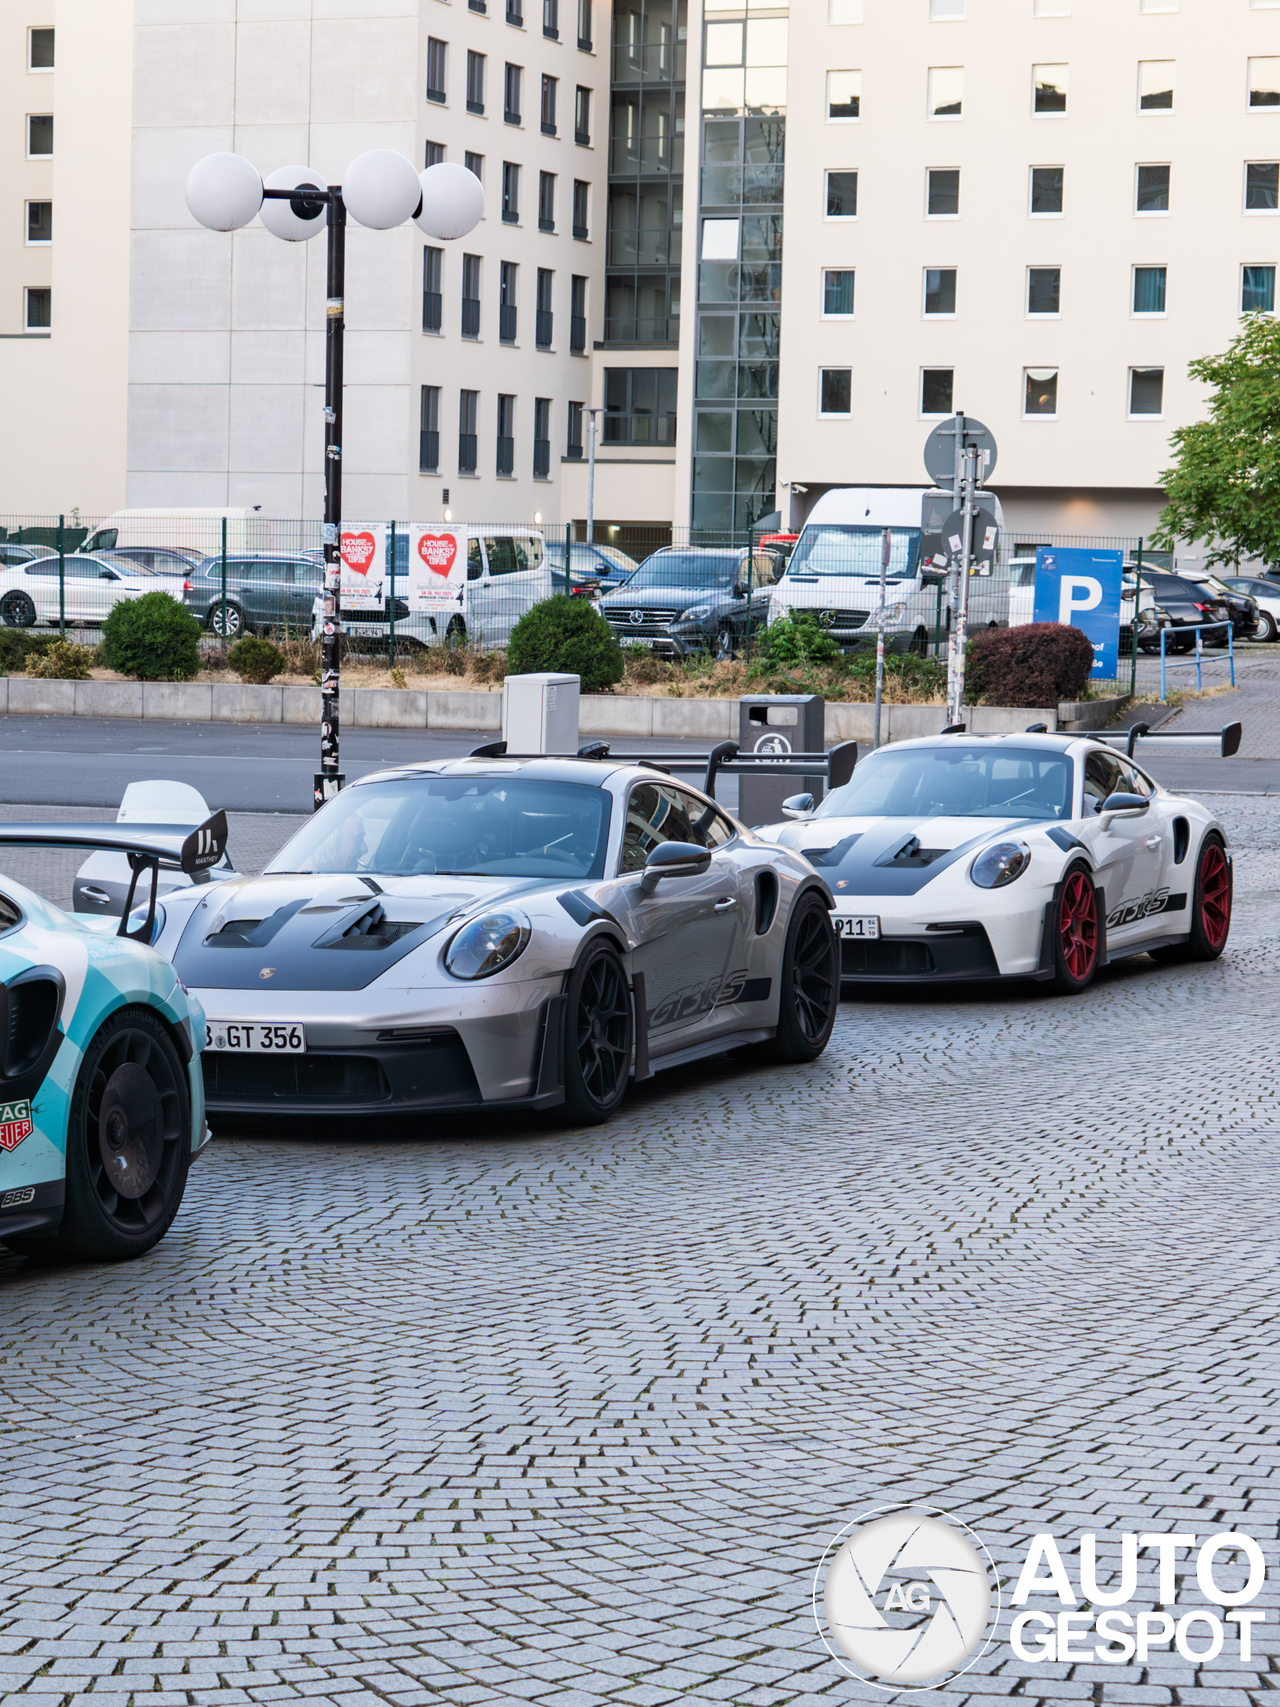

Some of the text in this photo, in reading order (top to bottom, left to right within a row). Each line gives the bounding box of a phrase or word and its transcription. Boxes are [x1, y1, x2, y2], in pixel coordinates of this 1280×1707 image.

[342, 538, 367, 546] HOUSE
[423, 540, 448, 548] HOUSE
[340, 545, 373, 556] BANKSY
[421, 547, 455, 558] BANKSY
[1058, 574, 1103, 626] P
[195, 855, 219, 865] MANTHEY
[227, 1025, 254, 1049] GT
[260, 1026, 302, 1049] 356
[1, 1187, 36, 1209] BBS
